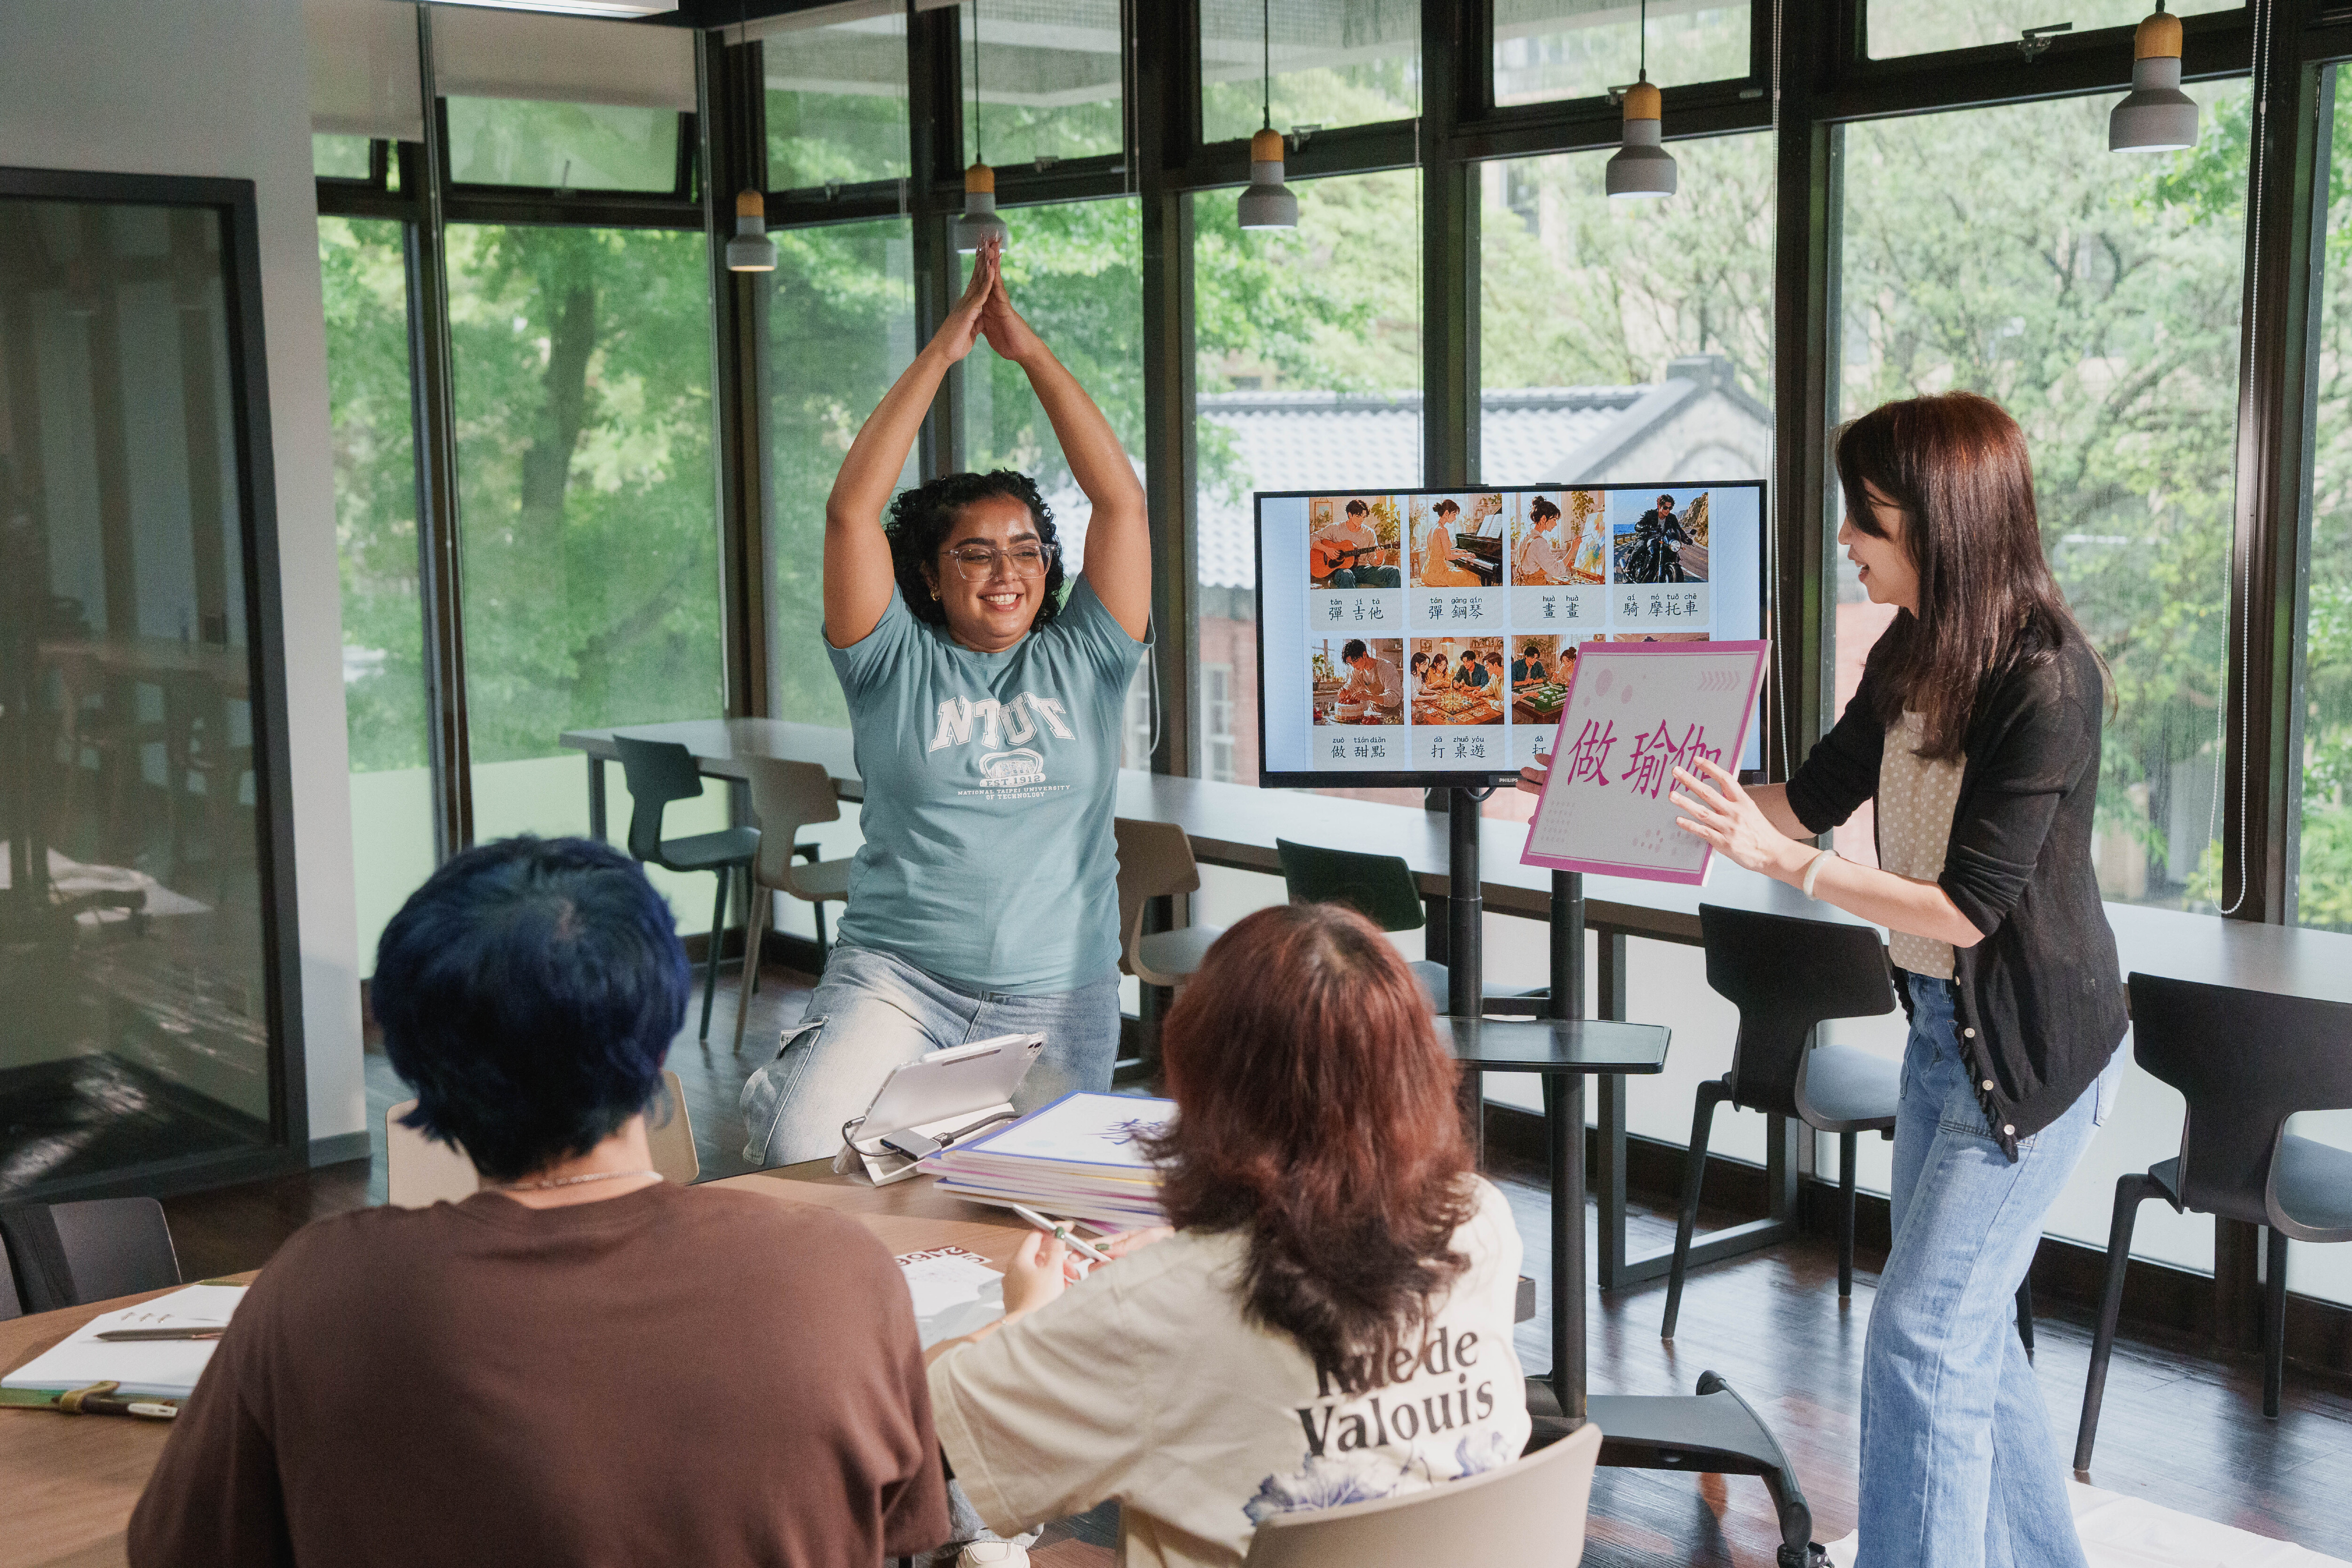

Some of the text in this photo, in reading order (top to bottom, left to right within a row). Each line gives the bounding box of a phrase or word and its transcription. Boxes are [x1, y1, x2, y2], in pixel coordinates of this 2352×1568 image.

[1627, 593, 1636, 602] qí
[1328, 605, 1384, 621] 彈 吉他
[1429, 604, 1484, 620] 彈 鋼琴
[1623, 600, 1699, 617] 騎 摩托車
[929, 692, 1075, 752] NTUT
[1331, 744, 1386, 758] 做 甜點
[1431, 743, 1486, 759] 打 桌遊
[1567, 719, 1617, 786] 做
[1425, 1326, 1478, 1375] de
[1295, 1373, 1494, 1457] Valouis
